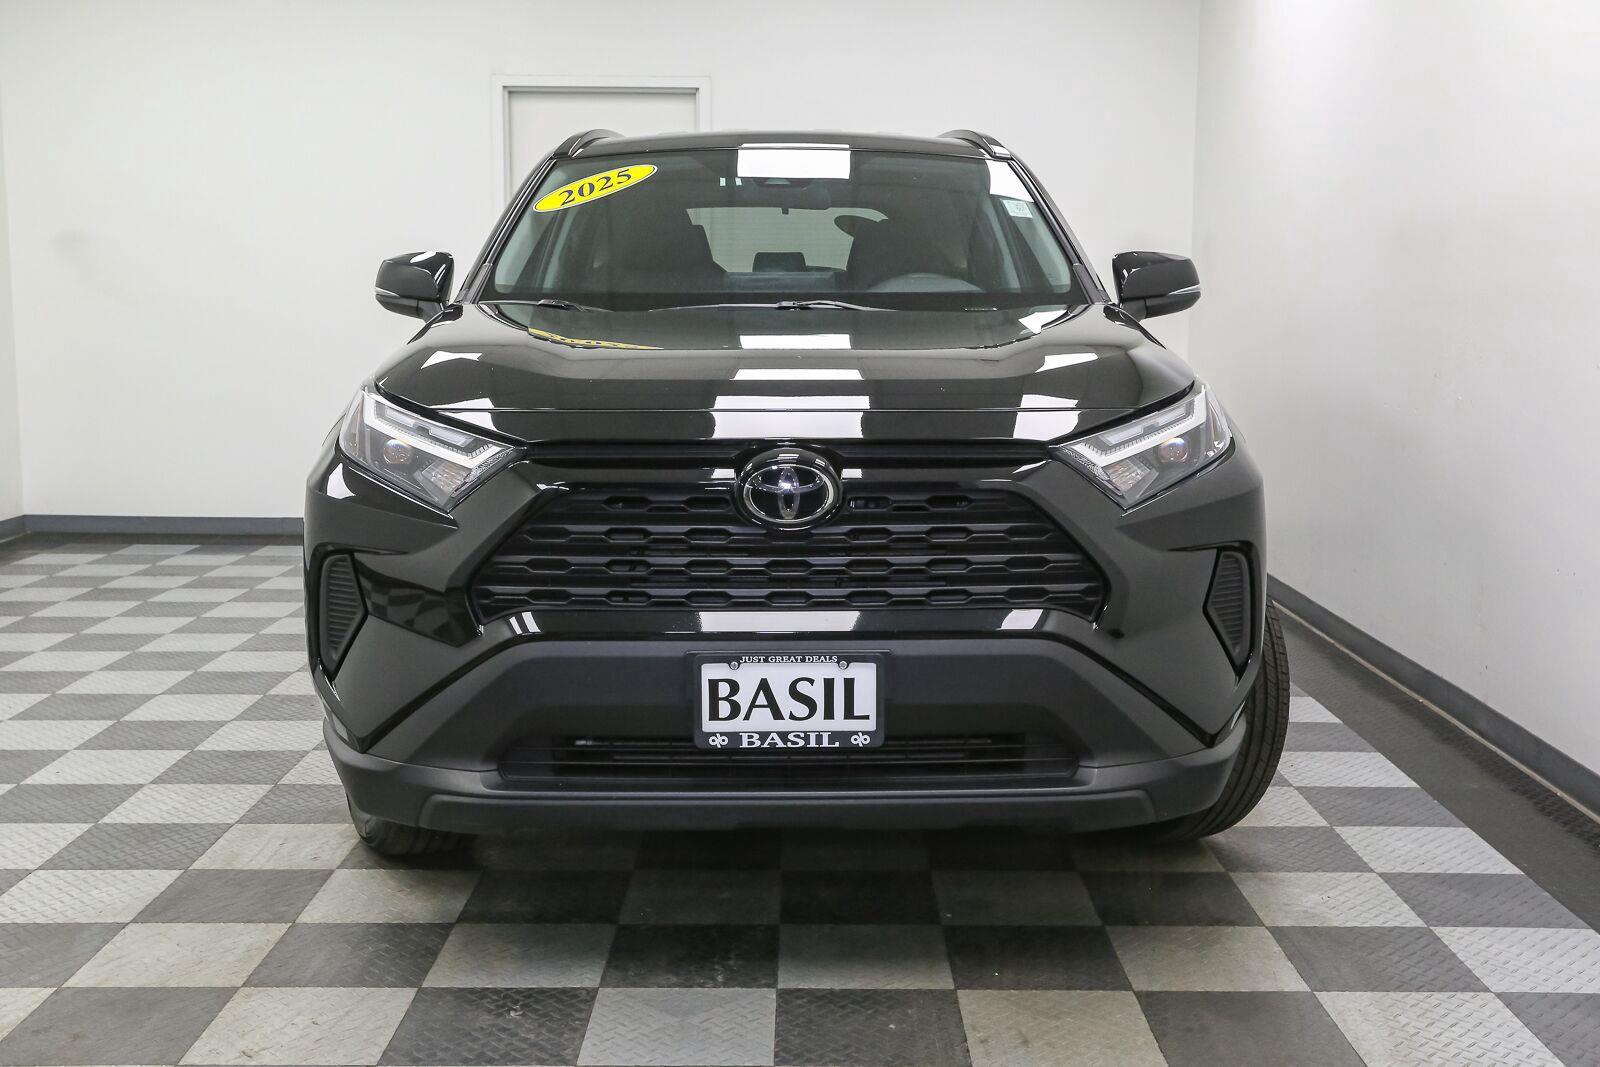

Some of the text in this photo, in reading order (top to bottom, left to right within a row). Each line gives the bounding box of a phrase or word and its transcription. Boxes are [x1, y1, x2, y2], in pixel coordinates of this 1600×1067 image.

[558, 168, 631, 206] 2025
[708, 677, 870, 721] BASIL
[739, 732, 840, 748] BASIL
